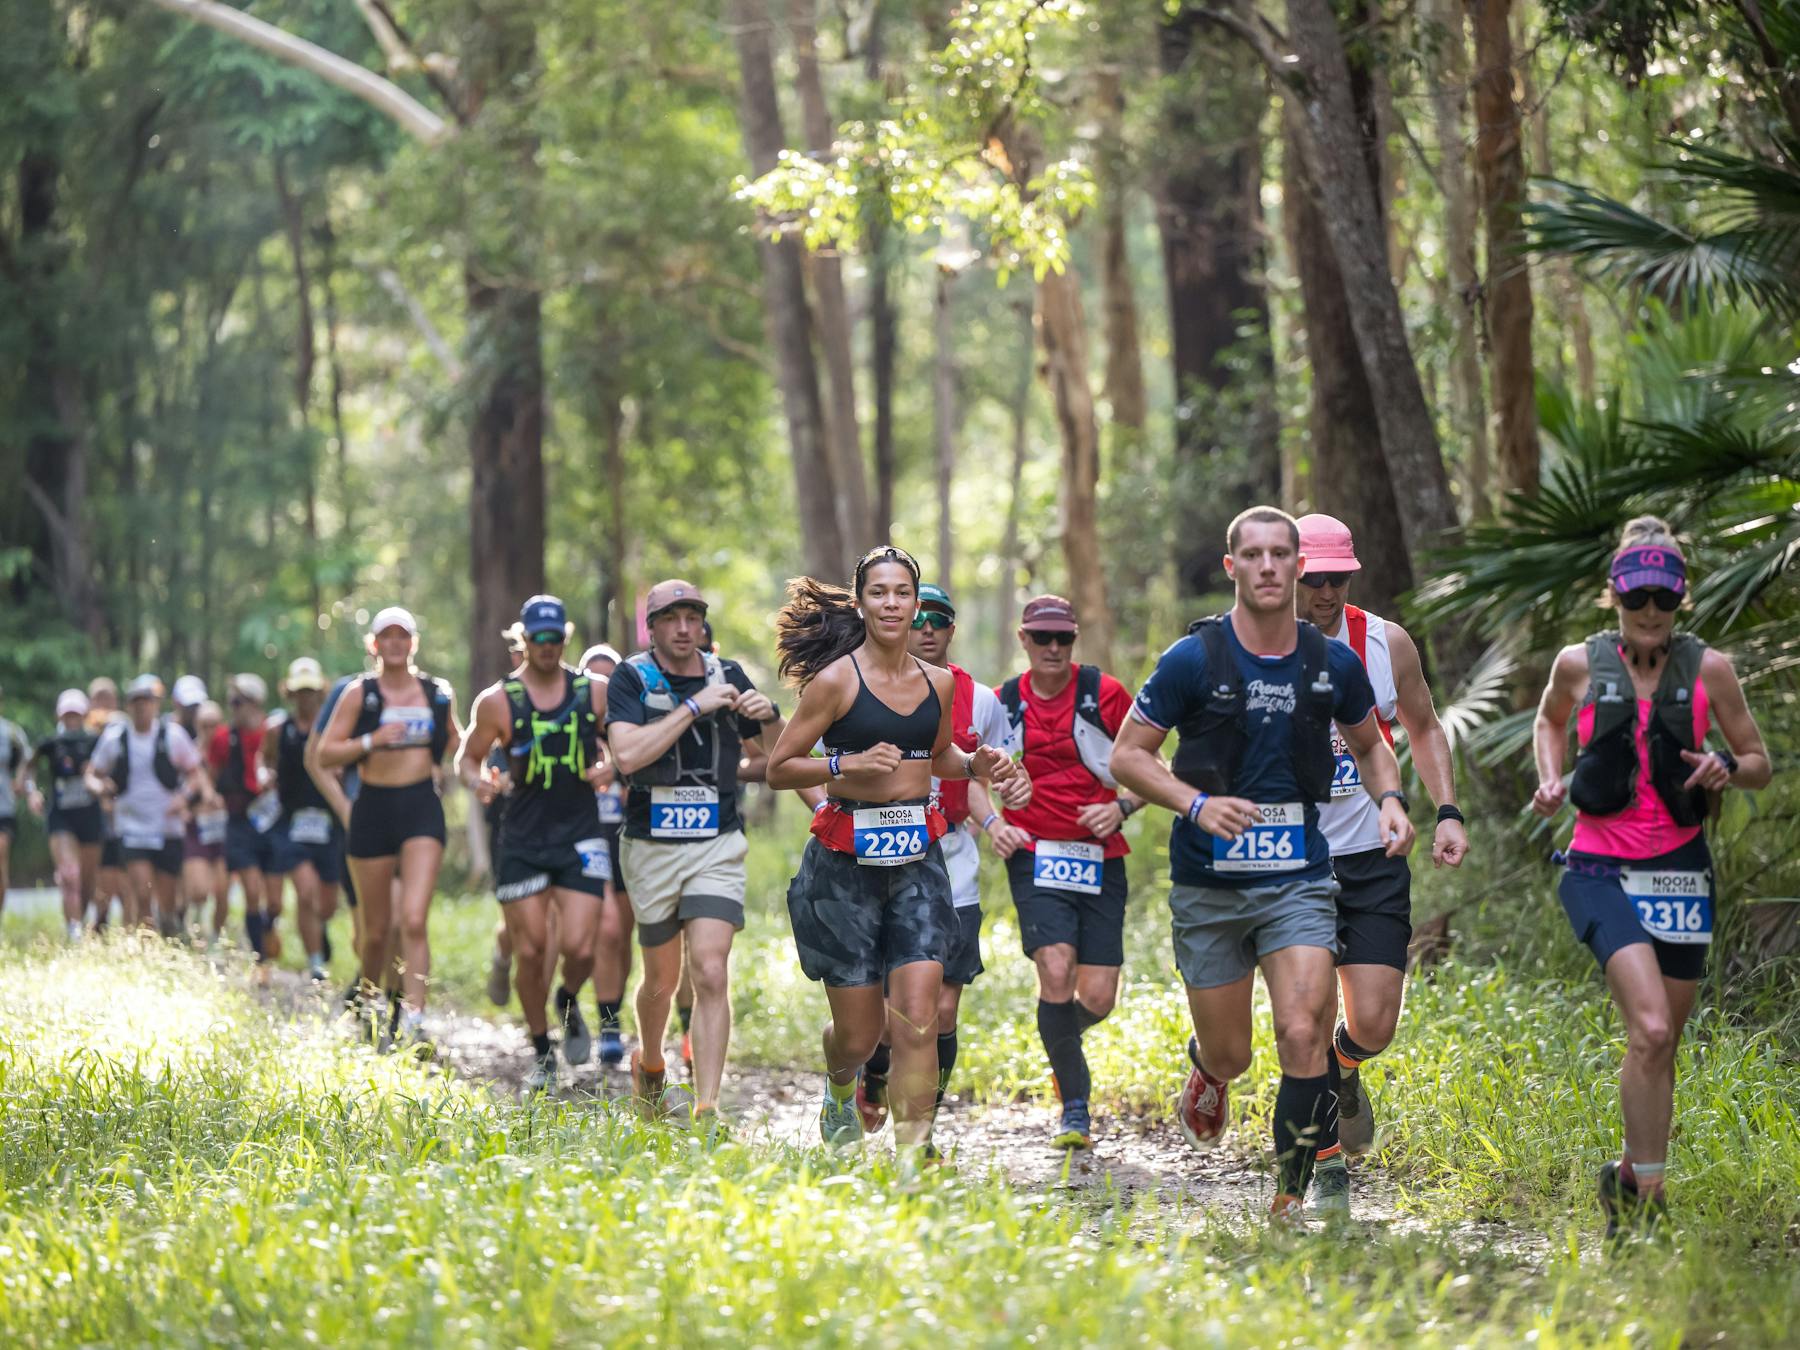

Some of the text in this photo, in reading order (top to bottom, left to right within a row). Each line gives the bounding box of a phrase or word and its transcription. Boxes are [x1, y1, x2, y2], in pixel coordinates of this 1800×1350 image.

[910, 749, 929, 758] NIKE
[674, 789, 706, 797] NOOSA
[660, 806, 711, 829] 2199
[879, 809, 913, 820] NOOSA
[864, 830, 922, 857] 2296
[1226, 830, 1293, 859] 2156
[1039, 858, 1097, 885] 2034
[1652, 876, 1697, 886] NOOSA
[1637, 900, 1702, 931] 2316
